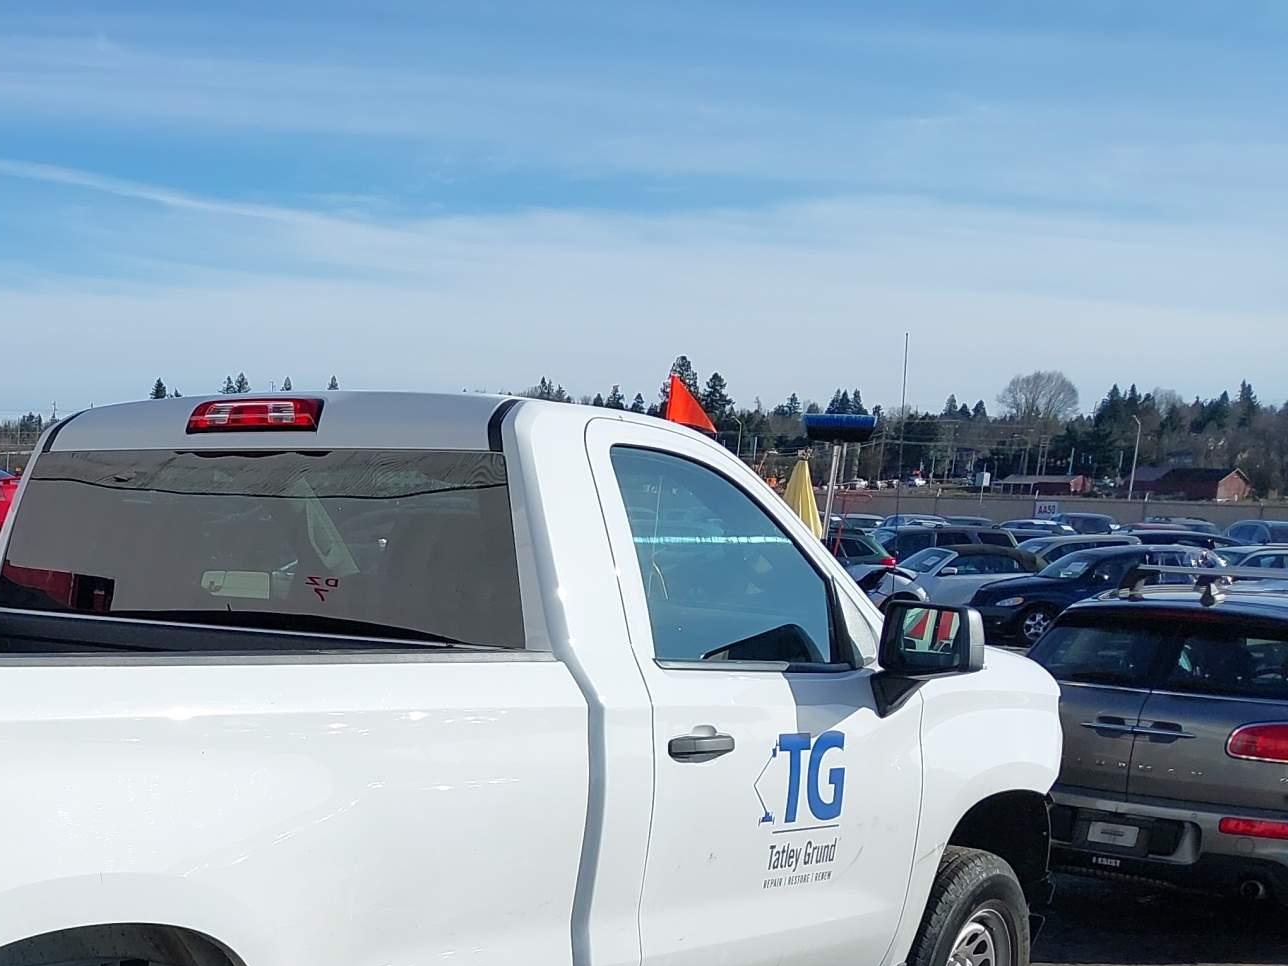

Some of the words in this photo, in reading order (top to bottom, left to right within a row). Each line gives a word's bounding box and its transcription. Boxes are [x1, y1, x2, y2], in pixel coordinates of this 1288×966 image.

[779, 730, 845, 823] TG
[768, 843, 802, 872] Tatley
[803, 838, 838, 866] Grund
[763, 877, 784, 888] REPAIR
[787, 874, 811, 886] RESTORE
[814, 871, 833, 881] RENEW
